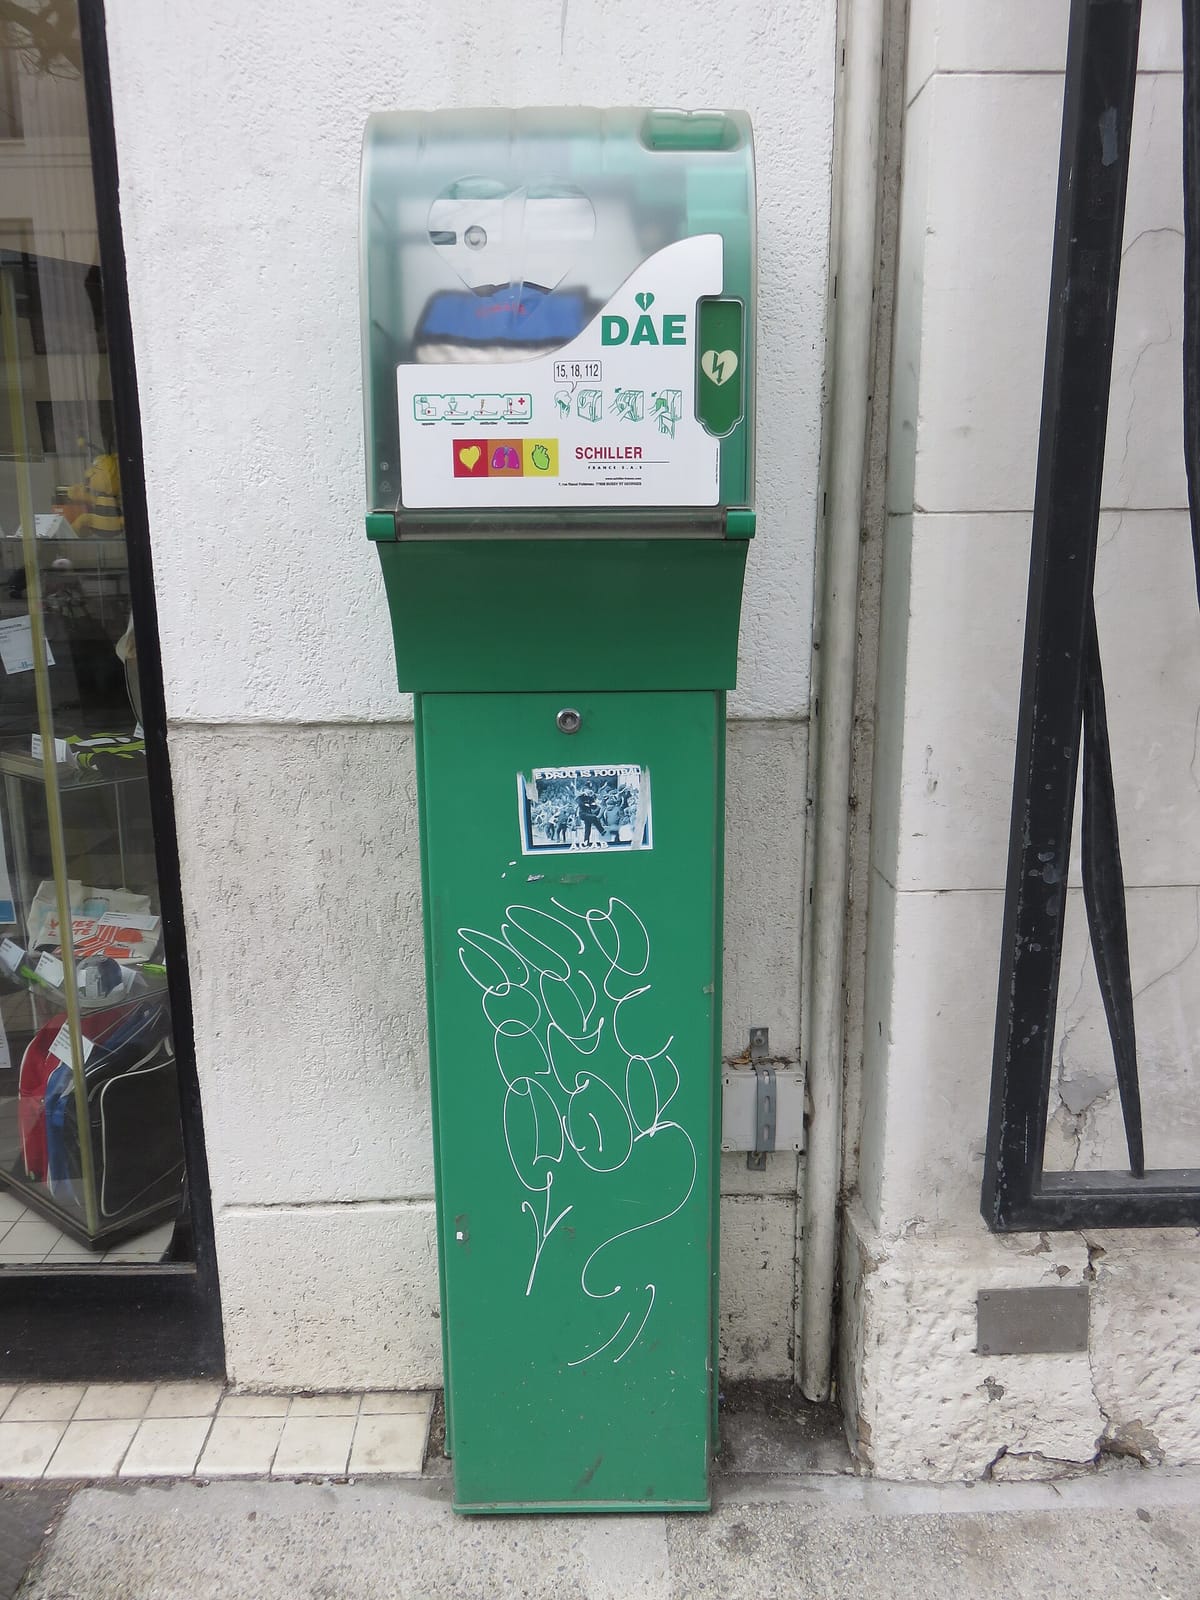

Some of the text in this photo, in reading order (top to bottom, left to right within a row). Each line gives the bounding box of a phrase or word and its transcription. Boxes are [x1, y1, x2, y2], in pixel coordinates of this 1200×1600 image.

[601, 314, 686, 346] DAE
[556, 363, 599, 379] 15, 18, 112
[575, 446, 643, 460] SCHILLER
[545, 769, 577, 780] DRUG
[580, 769, 592, 778] IS
